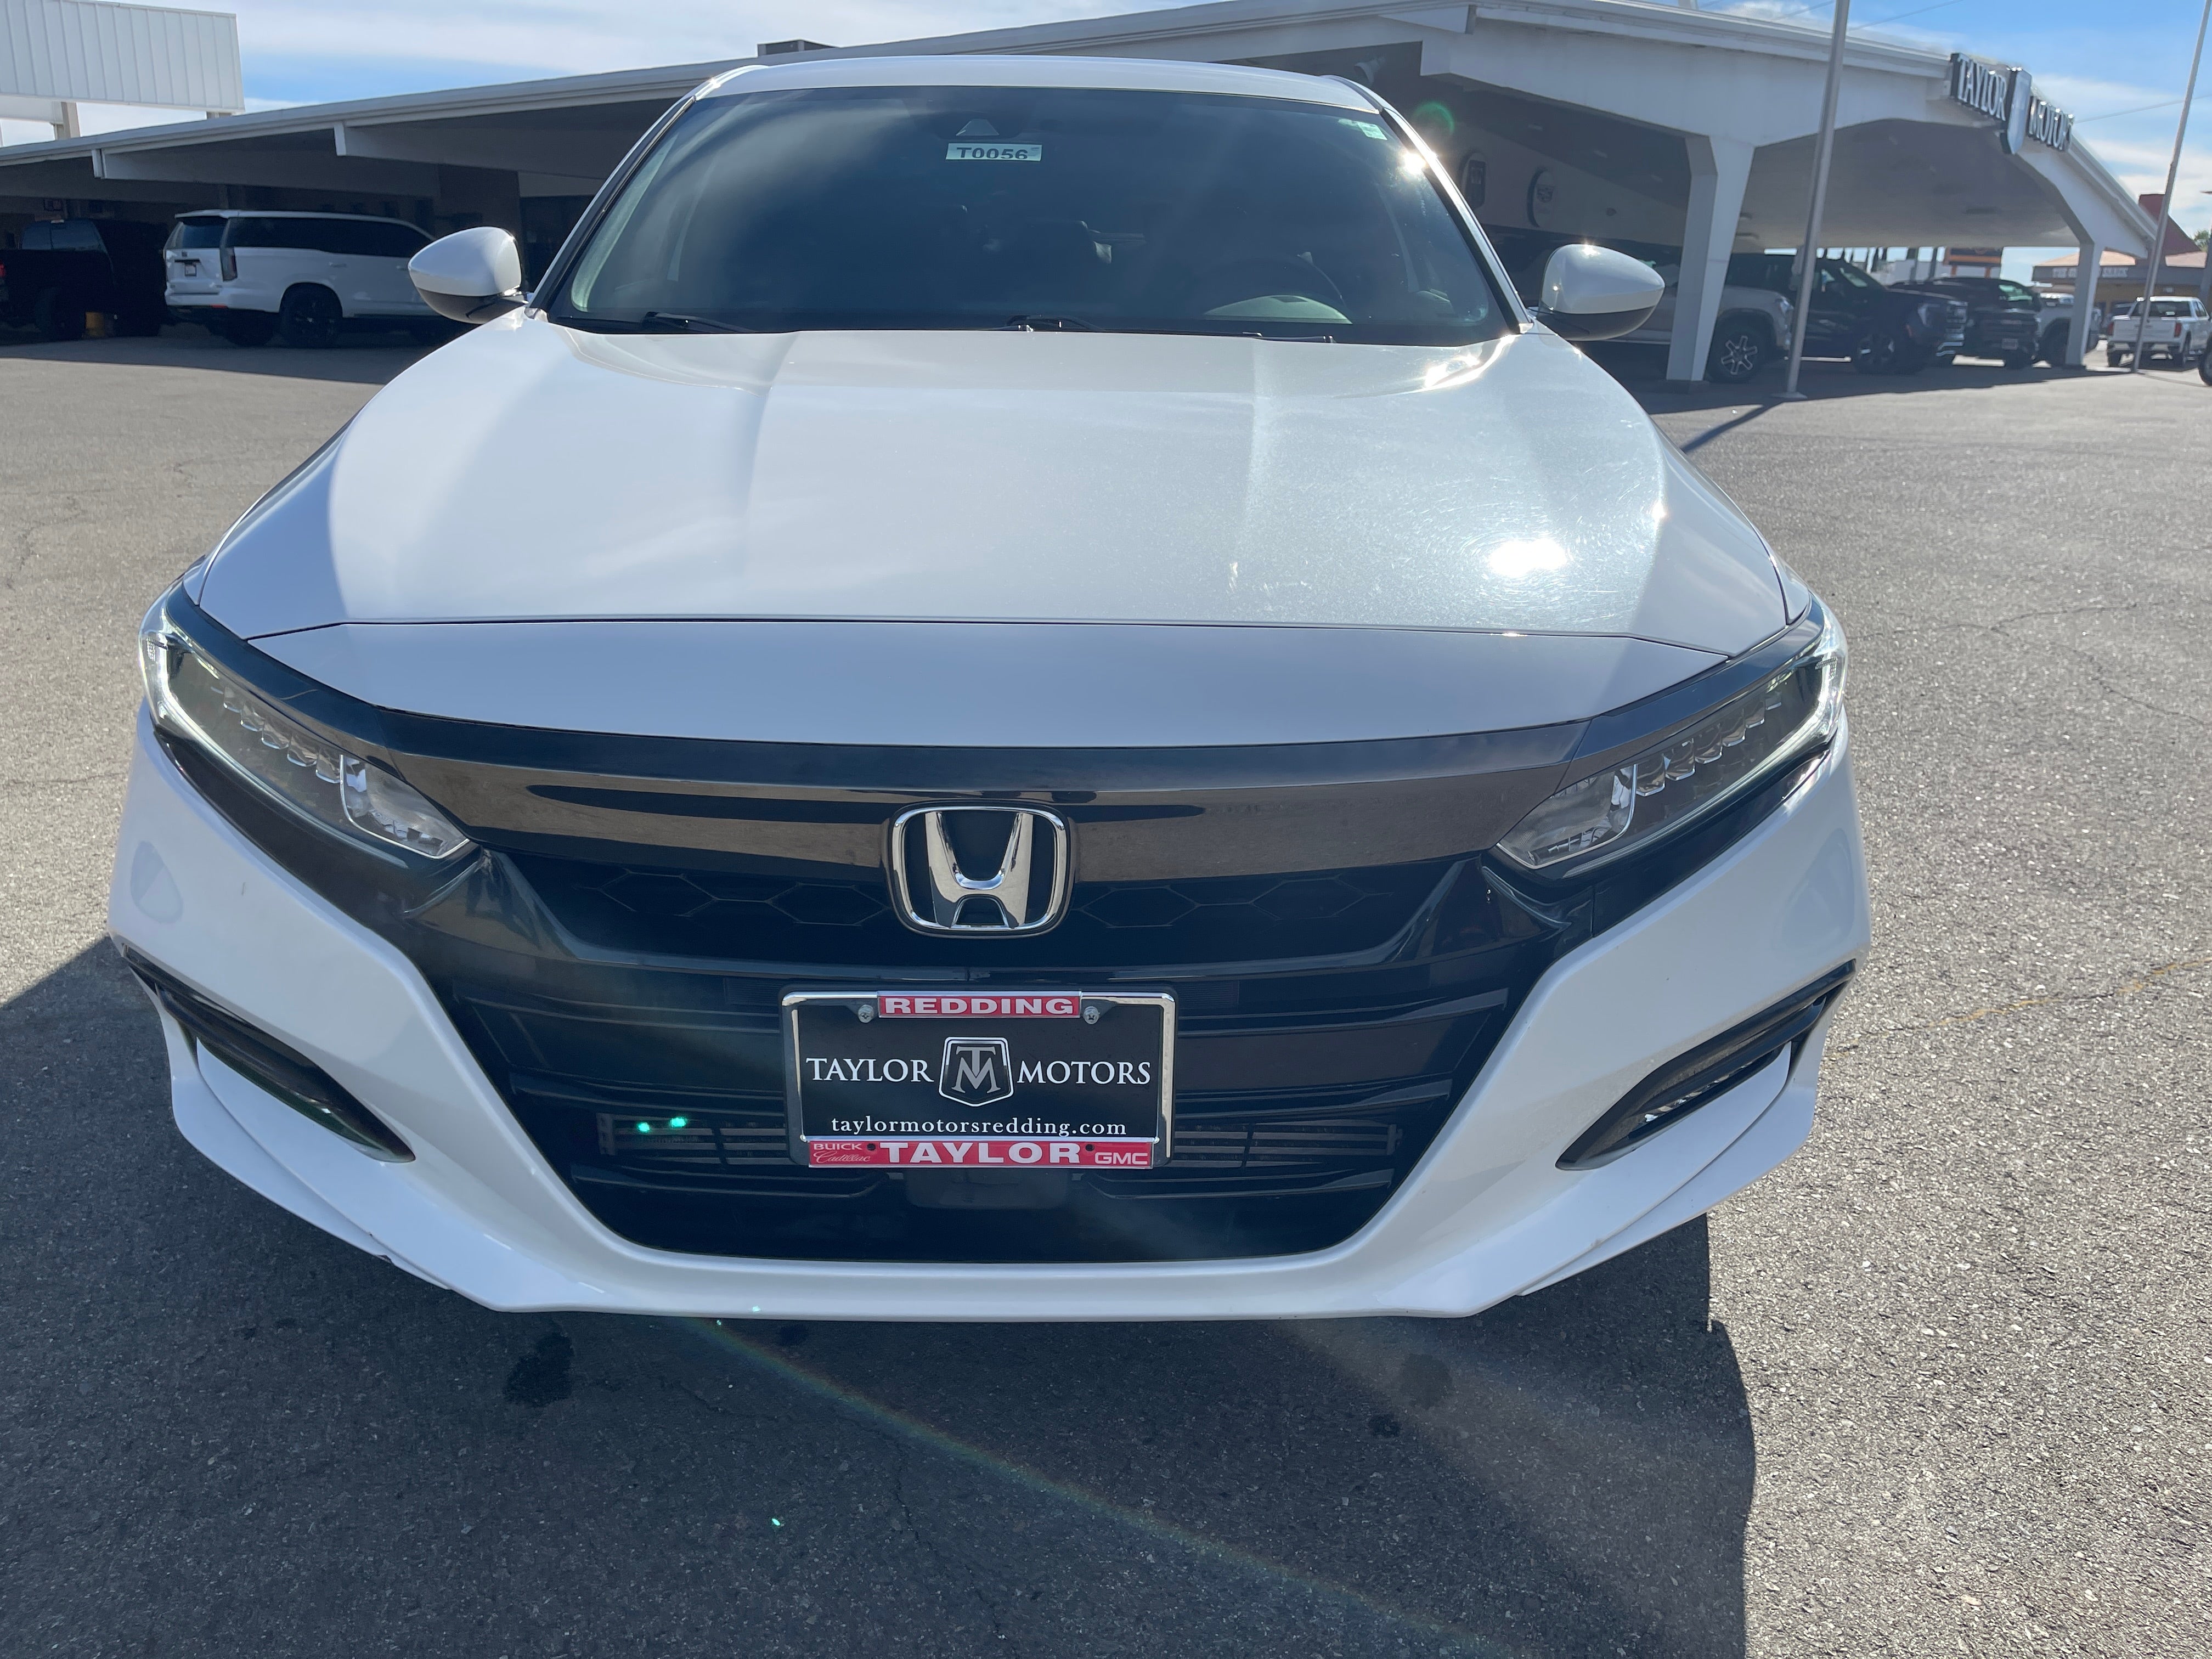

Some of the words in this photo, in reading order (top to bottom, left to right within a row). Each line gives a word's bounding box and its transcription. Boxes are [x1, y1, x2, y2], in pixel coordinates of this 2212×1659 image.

[1957, 54, 2008, 121] TAYLOR
[956, 147, 1028, 160] T0056
[884, 997, 1074, 1015] REDDING
[805, 1057, 935, 1083] TAYLOR
[1016, 1060, 1151, 1085] MOTORS
[831, 1115, 1127, 1137] taylormotorsredding.com
[813, 1143, 862, 1151] BUICK
[879, 1142, 1081, 1164] TAYLOR
[812, 1150, 871, 1164] Cadillac
[1094, 1152, 1148, 1165] GMC
